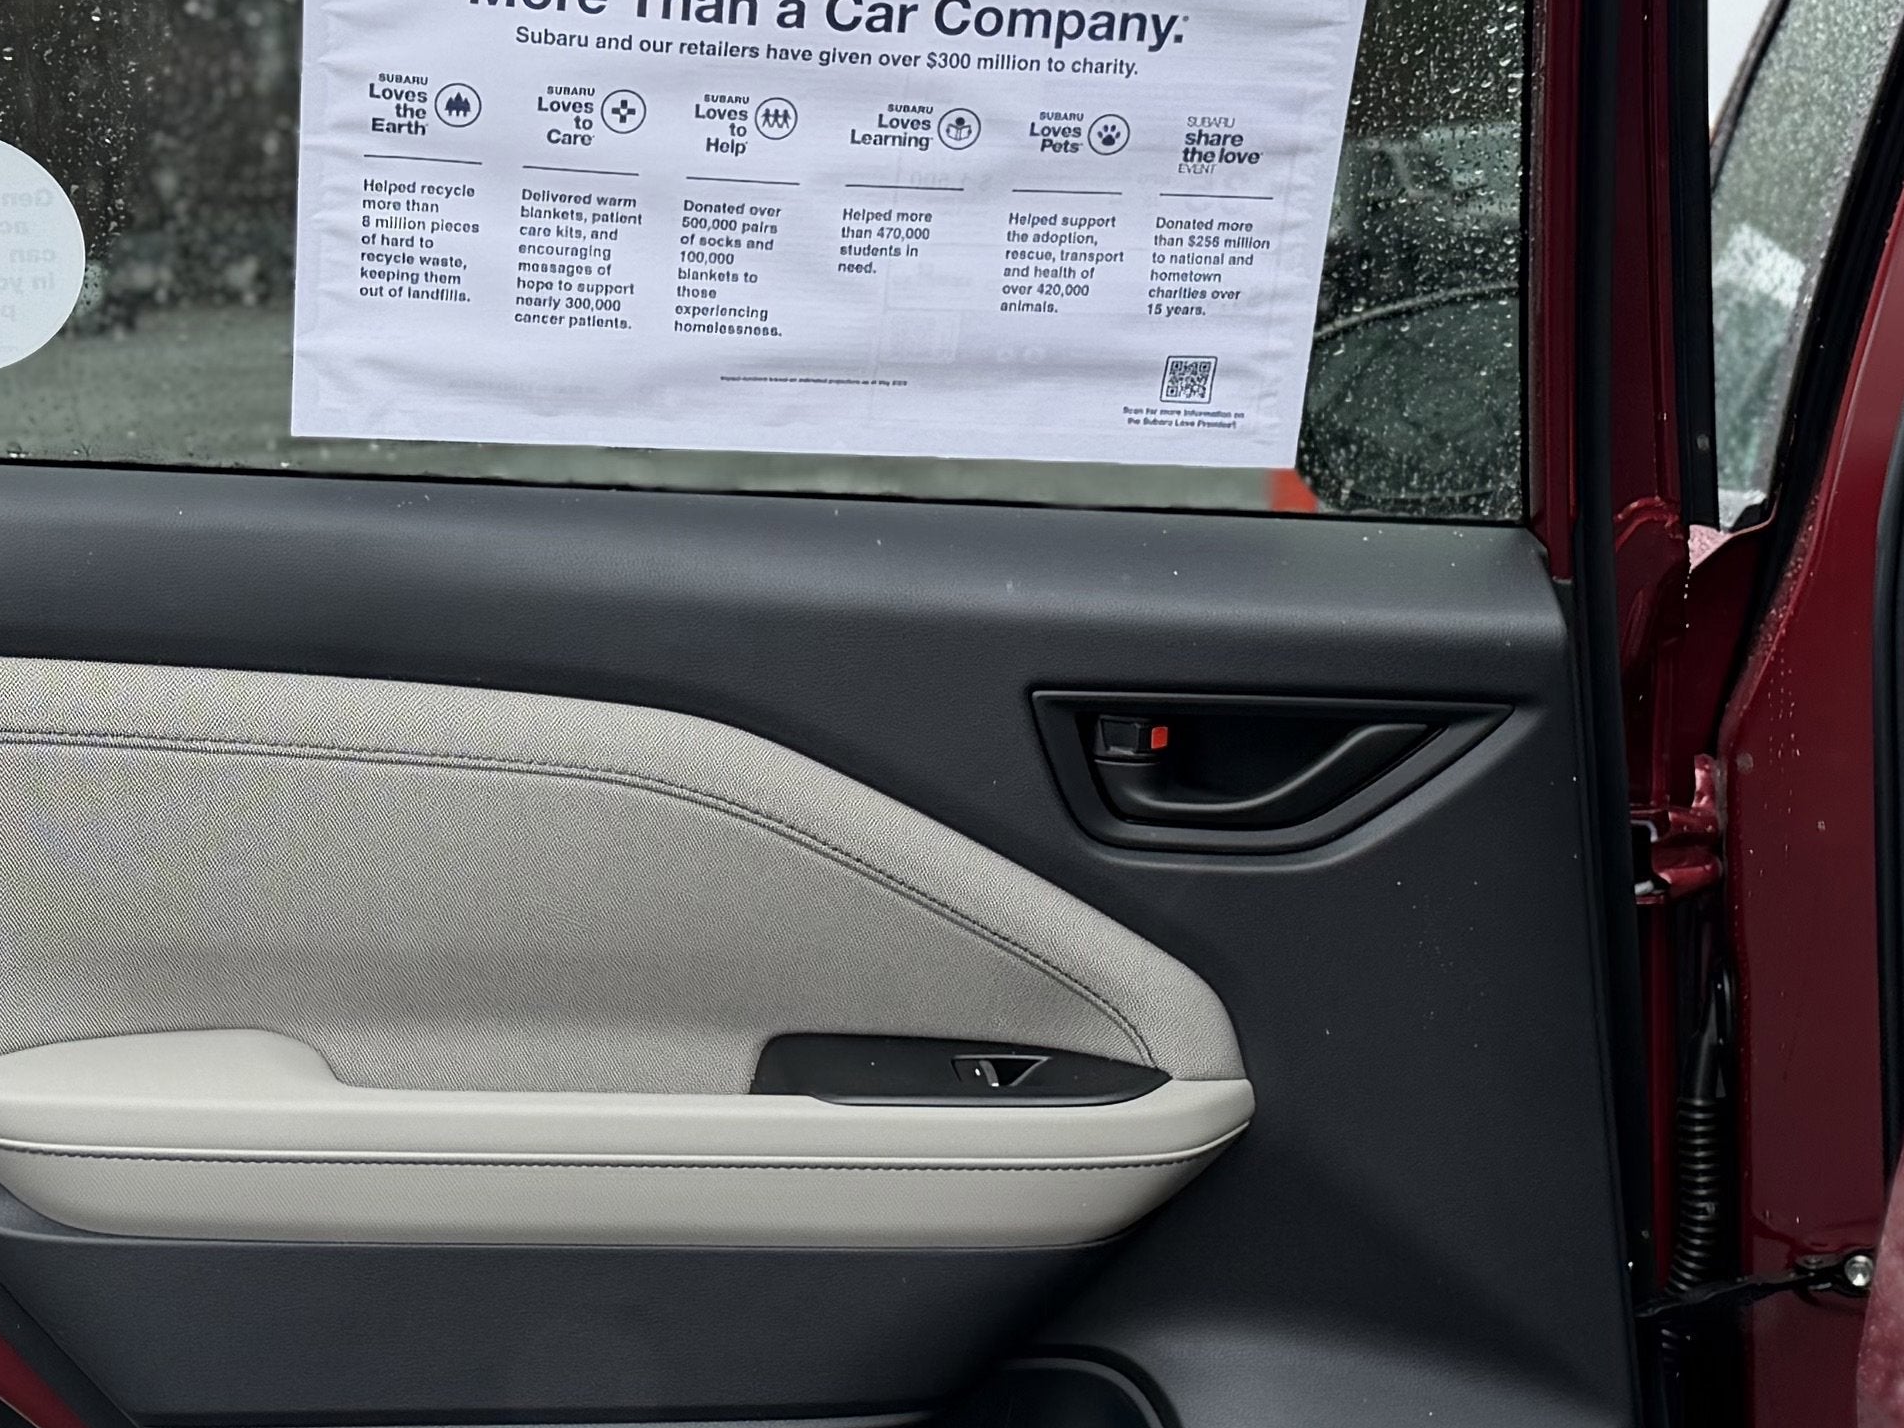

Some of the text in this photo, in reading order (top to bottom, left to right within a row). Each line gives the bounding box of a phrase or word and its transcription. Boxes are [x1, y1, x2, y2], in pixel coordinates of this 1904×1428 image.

[516, 26, 1138, 79] Subaru and our retailers have given over $300 million to charity.
[369, 83, 428, 104] Loves
[395, 102, 427, 122] the
[537, 96, 594, 114] Loves
[694, 103, 748, 124] Loves
[574, 115, 593, 130] to
[878, 113, 932, 131] Loves
[1029, 121, 1082, 140] Loves
[729, 122, 747, 140] to
[1184, 128, 1244, 149] share
[1182, 147, 1260, 166] the love
[364, 178, 475, 199] Helped recycle
[362, 199, 439, 213] more than
[522, 188, 637, 208] Delivered warm
[520, 205, 642, 226] blankets, patient
[683, 199, 782, 218] Donated over
[842, 208, 933, 224] Helped more
[362, 215, 480, 234] 8 million pieces
[682, 216, 778, 234] 500,000 pairs
[1008, 212, 1116, 230] Helped support
[1156, 216, 1254, 232] Donated more
[361, 233, 434, 249] of hard to
[519, 225, 618, 241] care kits, and
[841, 226, 930, 242] than 470,000
[1006, 230, 1098, 247] the adoption,
[680, 233, 774, 251] of socks and
[840, 244, 918, 257] students in
[1154, 234, 1270, 250] than $256 million
[361, 252, 467, 270] recycle waste,
[518, 244, 611, 261] encouraging
[680, 250, 734, 266] 100,000
[1005, 249, 1124, 265] rescue, transport
[1152, 252, 1254, 266] to national and
[360, 266, 461, 285] keeping them
[518, 262, 612, 278] messages of
[678, 267, 758, 284] blankets to
[838, 261, 877, 274] need.
[1003, 265, 1095, 280] and health of
[1150, 268, 1222, 283] hometown
[359, 286, 470, 302] out of landfills.
[517, 276, 634, 296] hope to support
[676, 285, 717, 299] those
[1002, 283, 1090, 298] over 420,000
[1148, 286, 1242, 300] charities over
[516, 296, 621, 312] nearly 300,000
[1000, 300, 1058, 313] animals.
[1147, 303, 1206, 318] 15 years.
[514, 313, 632, 330] cancer patients.
[675, 304, 768, 323] experiencing
[674, 320, 782, 337] homelessness.
